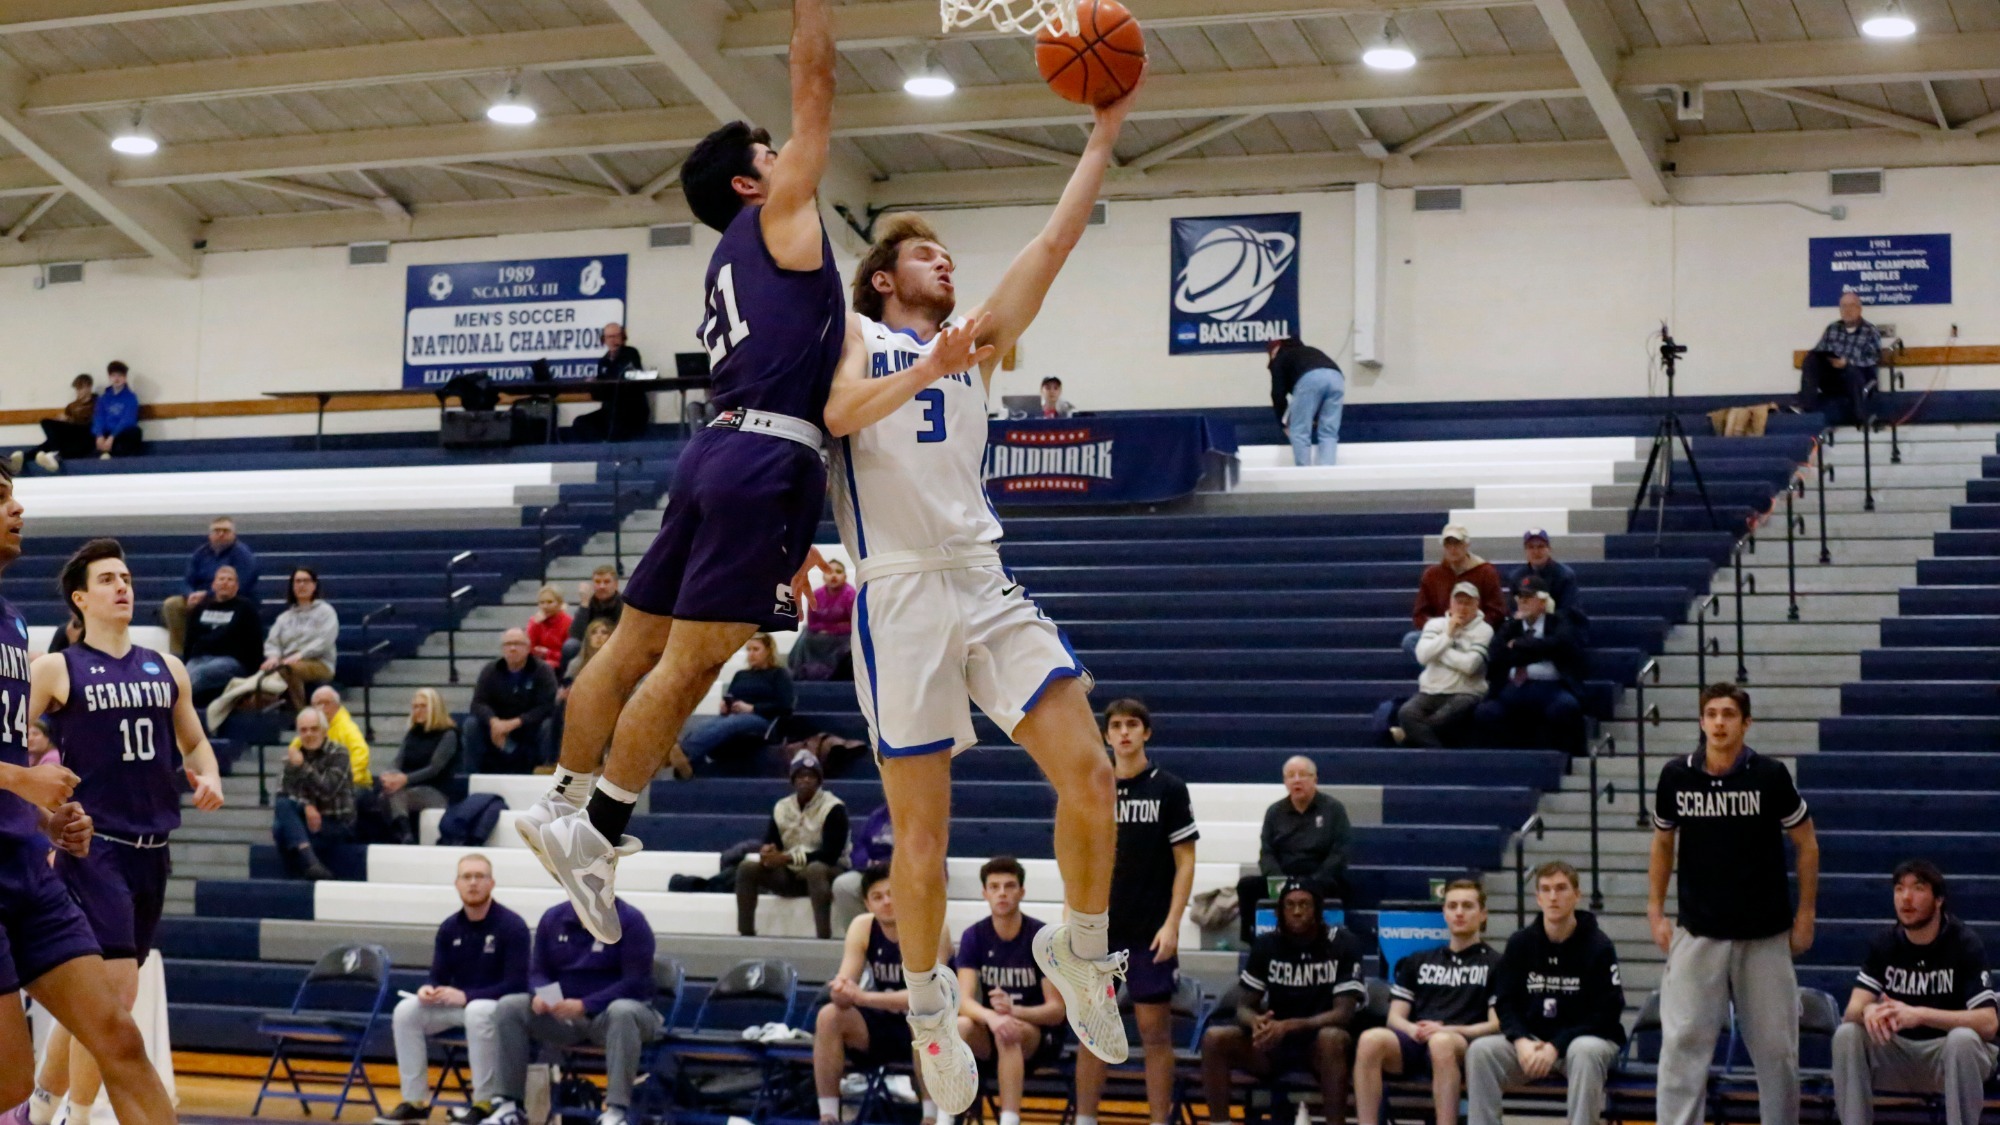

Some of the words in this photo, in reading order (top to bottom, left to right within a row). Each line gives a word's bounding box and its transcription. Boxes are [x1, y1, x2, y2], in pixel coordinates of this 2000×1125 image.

[498, 266, 535, 283] 1989
[1831, 260, 1872, 271] NATIONAL
[1860, 270, 1900, 281] DOUBLES
[472, 285, 509, 299] NCAA
[513, 284, 538, 297] DIV.
[542, 283, 558, 296] III
[454, 311, 502, 328] MEN'S
[509, 308, 575, 325] SOCCER
[704, 263, 750, 370] 21
[412, 332, 503, 357] NATIONAL
[509, 327, 604, 352] CHAMPION
[1200, 320, 1291, 344] BASKETBALL
[915, 388, 947, 443] 3
[1008, 480, 1084, 490] CONFERENCE
[84, 681, 171, 712] SCRANTON
[2, 690, 28, 748] 14
[119, 718, 156, 761] 10
[1114, 799, 1160, 823] NTON
[1676, 790, 1761, 817] SCRANTON
[981, 965, 1037, 988] SCRANTON
[1267, 959, 1339, 987] SCRANTON
[1417, 963, 1489, 987] SCRANTON
[1884, 966, 1953, 995] SCRANTON
